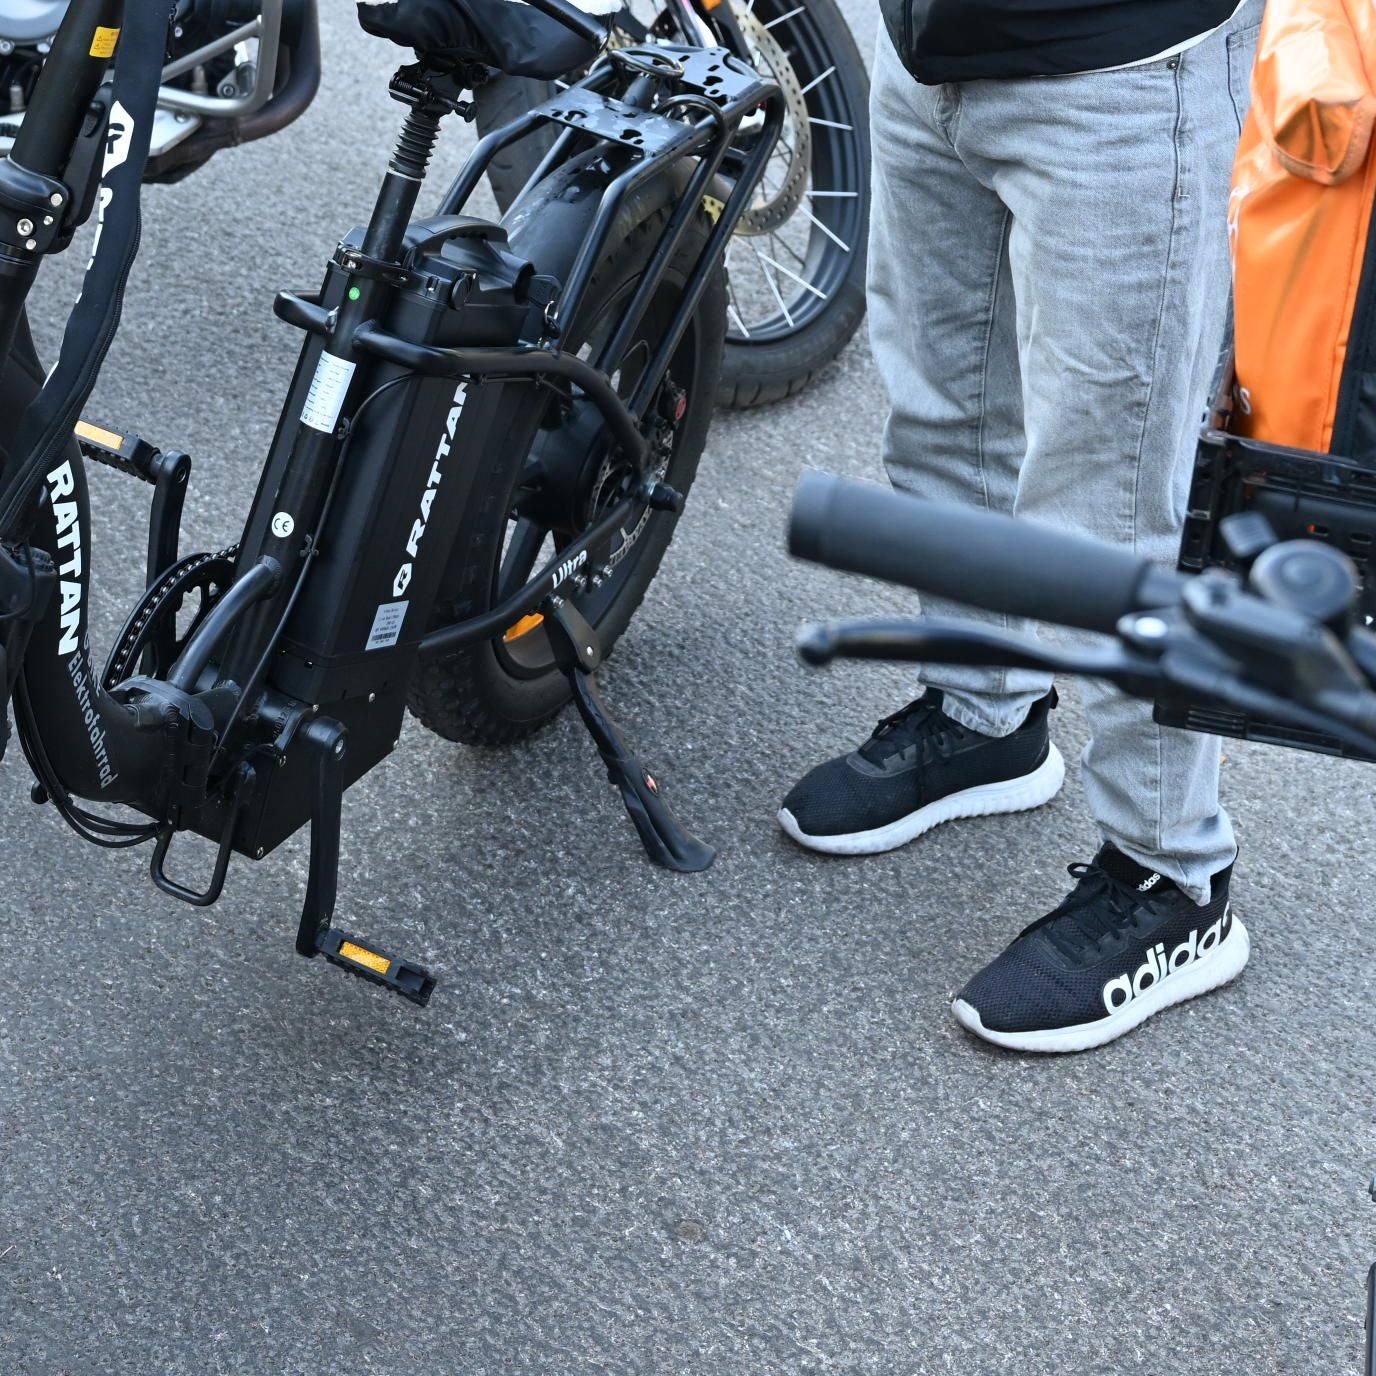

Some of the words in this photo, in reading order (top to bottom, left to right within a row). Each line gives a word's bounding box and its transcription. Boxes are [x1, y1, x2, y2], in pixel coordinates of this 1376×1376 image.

[274, 517, 290, 533] CE
[405, 374, 470, 558] RATTAN
[46, 460, 82, 655] RATTAN
[552, 550, 587, 589] Ultra
[67, 648, 118, 789] Elektrofahrrad
